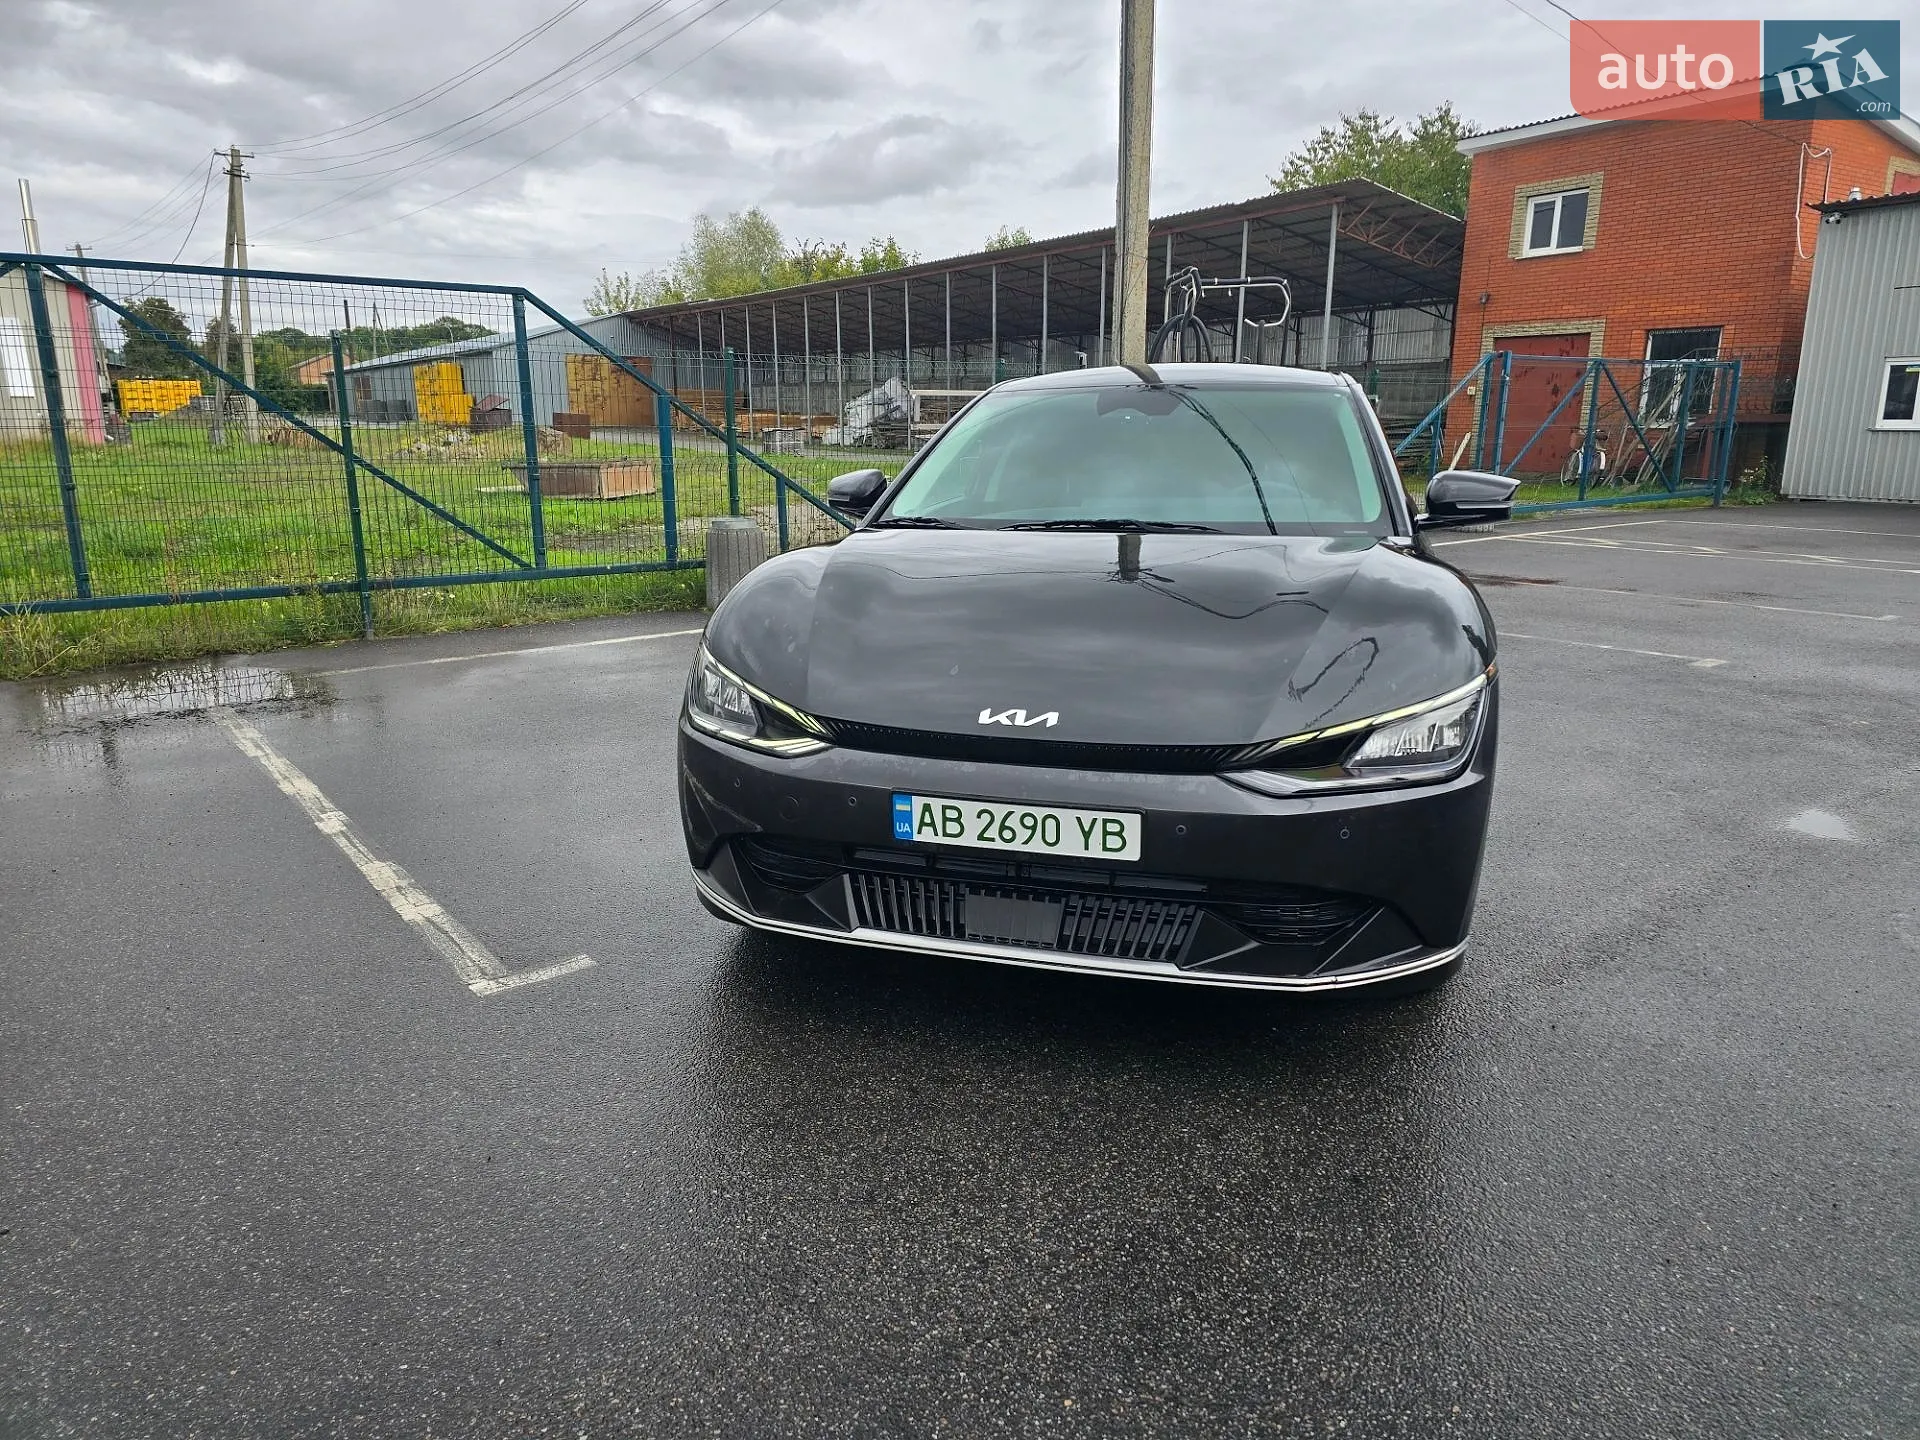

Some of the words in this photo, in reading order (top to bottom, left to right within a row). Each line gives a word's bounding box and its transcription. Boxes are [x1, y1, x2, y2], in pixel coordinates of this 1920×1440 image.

[978, 708, 1060, 728] KIA
[896, 821, 911, 833] UA
[917, 803, 965, 839] AB
[976, 808, 1061, 848] 2690
[1075, 816, 1128, 853] YB
